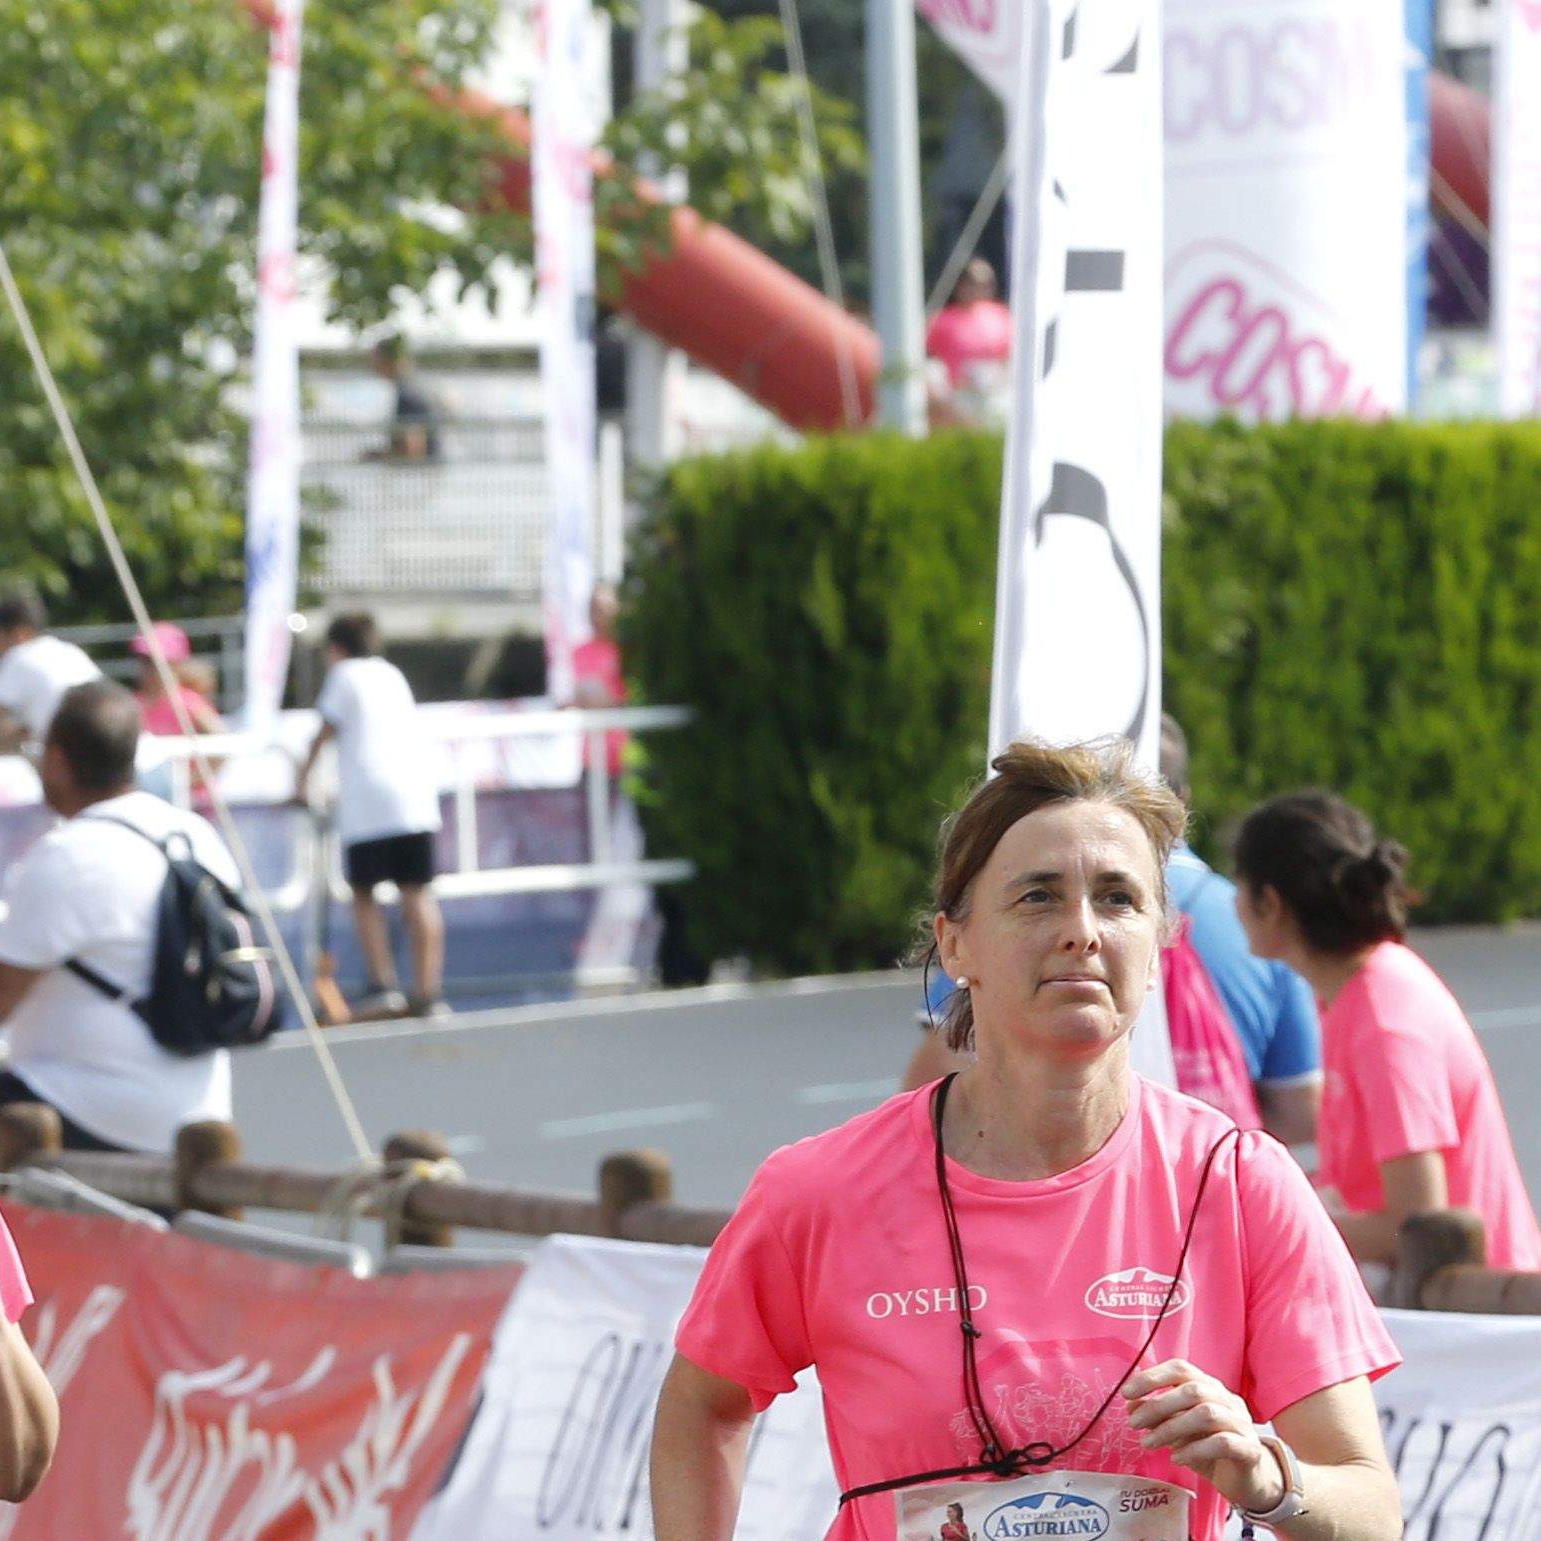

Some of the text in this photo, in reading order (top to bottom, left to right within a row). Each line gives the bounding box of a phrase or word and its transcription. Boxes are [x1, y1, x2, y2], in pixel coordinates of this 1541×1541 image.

[867, 1285, 988, 1318] OYSHO
[1119, 1495, 1169, 1512] SUMA
[994, 1516, 1102, 1538] ASTURIANA
